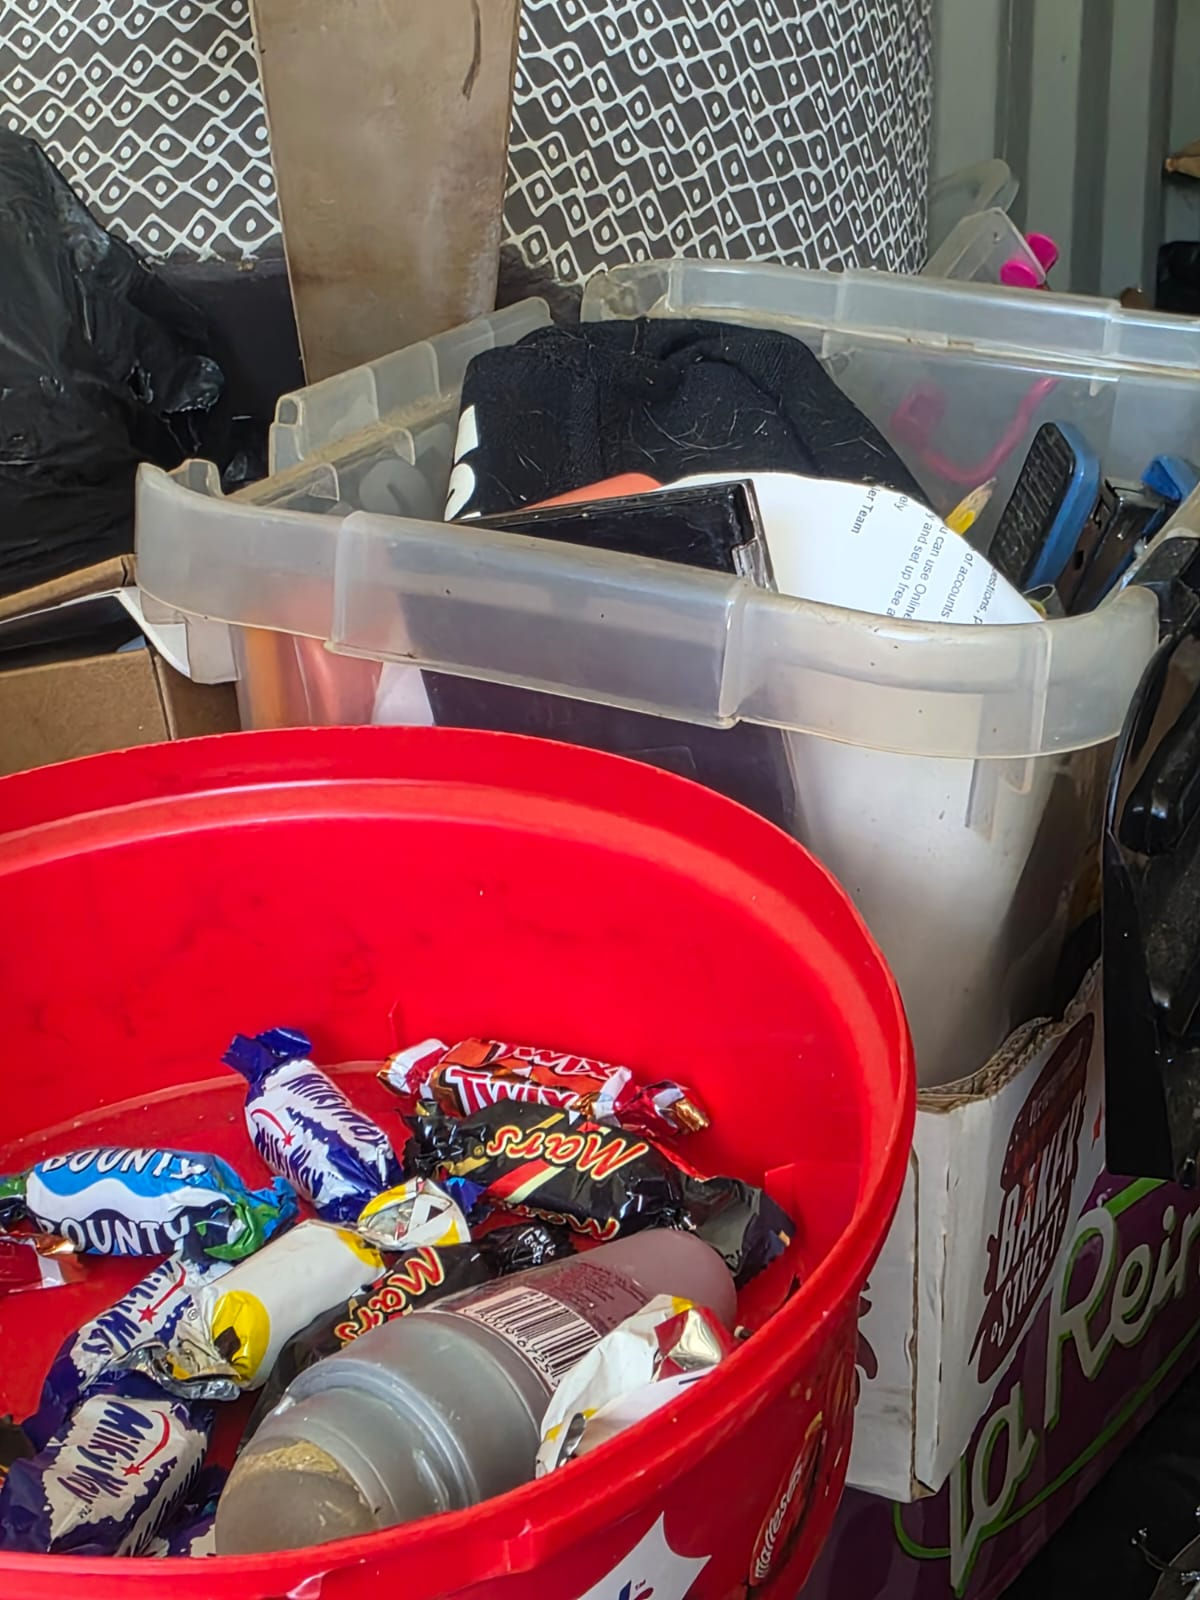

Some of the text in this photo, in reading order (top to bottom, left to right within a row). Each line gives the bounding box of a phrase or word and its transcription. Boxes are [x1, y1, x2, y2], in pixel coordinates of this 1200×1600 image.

[851, 504, 874, 534] Team
[917, 522, 933, 545] and
[908, 545, 923, 564] set
[930, 536, 945, 557] can
[900, 565, 915, 581] up
[920, 559, 935, 581] use
[891, 582, 910, 606] free
[941, 553, 975, 618] of accounts
[486, 1125, 649, 1181] Mars
[996, 1089, 1085, 1292] BAKER
[503, 1203, 621, 1241] Mar
[998, 1205, 1061, 1347] STREET
[334, 1246, 445, 1341] Mars
